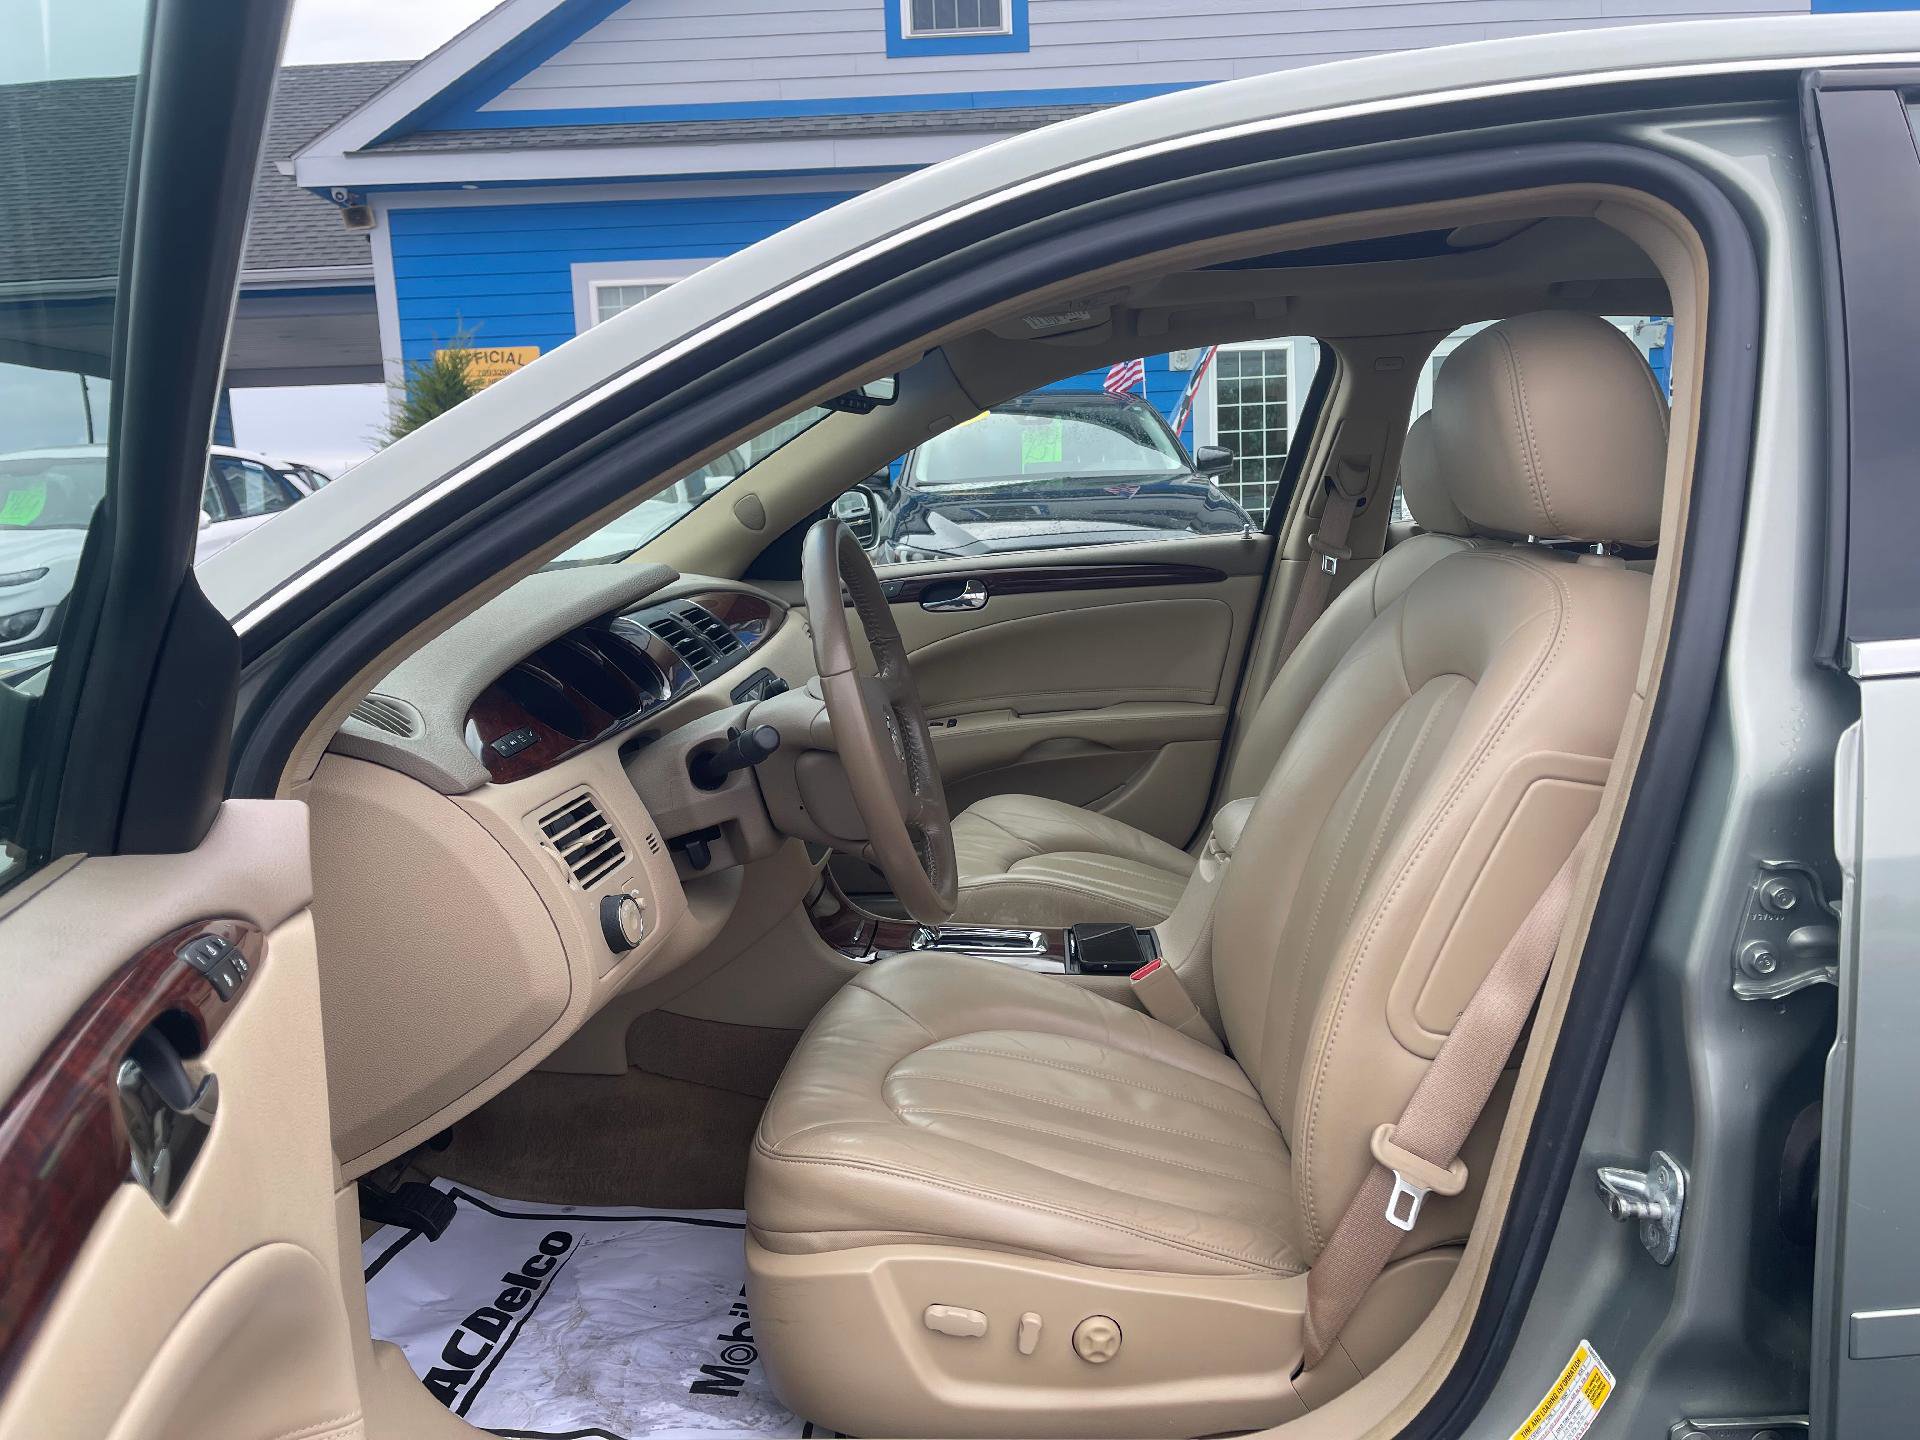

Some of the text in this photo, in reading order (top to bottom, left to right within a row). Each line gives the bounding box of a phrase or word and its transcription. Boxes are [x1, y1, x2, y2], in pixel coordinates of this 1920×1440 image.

[470, 350, 527, 367] FICIAL
[421, 1230, 573, 1409] ACDelco
[1521, 1426, 1533, 1438] TIRE
[1531, 1415, 1542, 1430] AND
[1540, 1393, 1559, 1416] LOADING
[1556, 1358, 1581, 1394] INFORMATION
